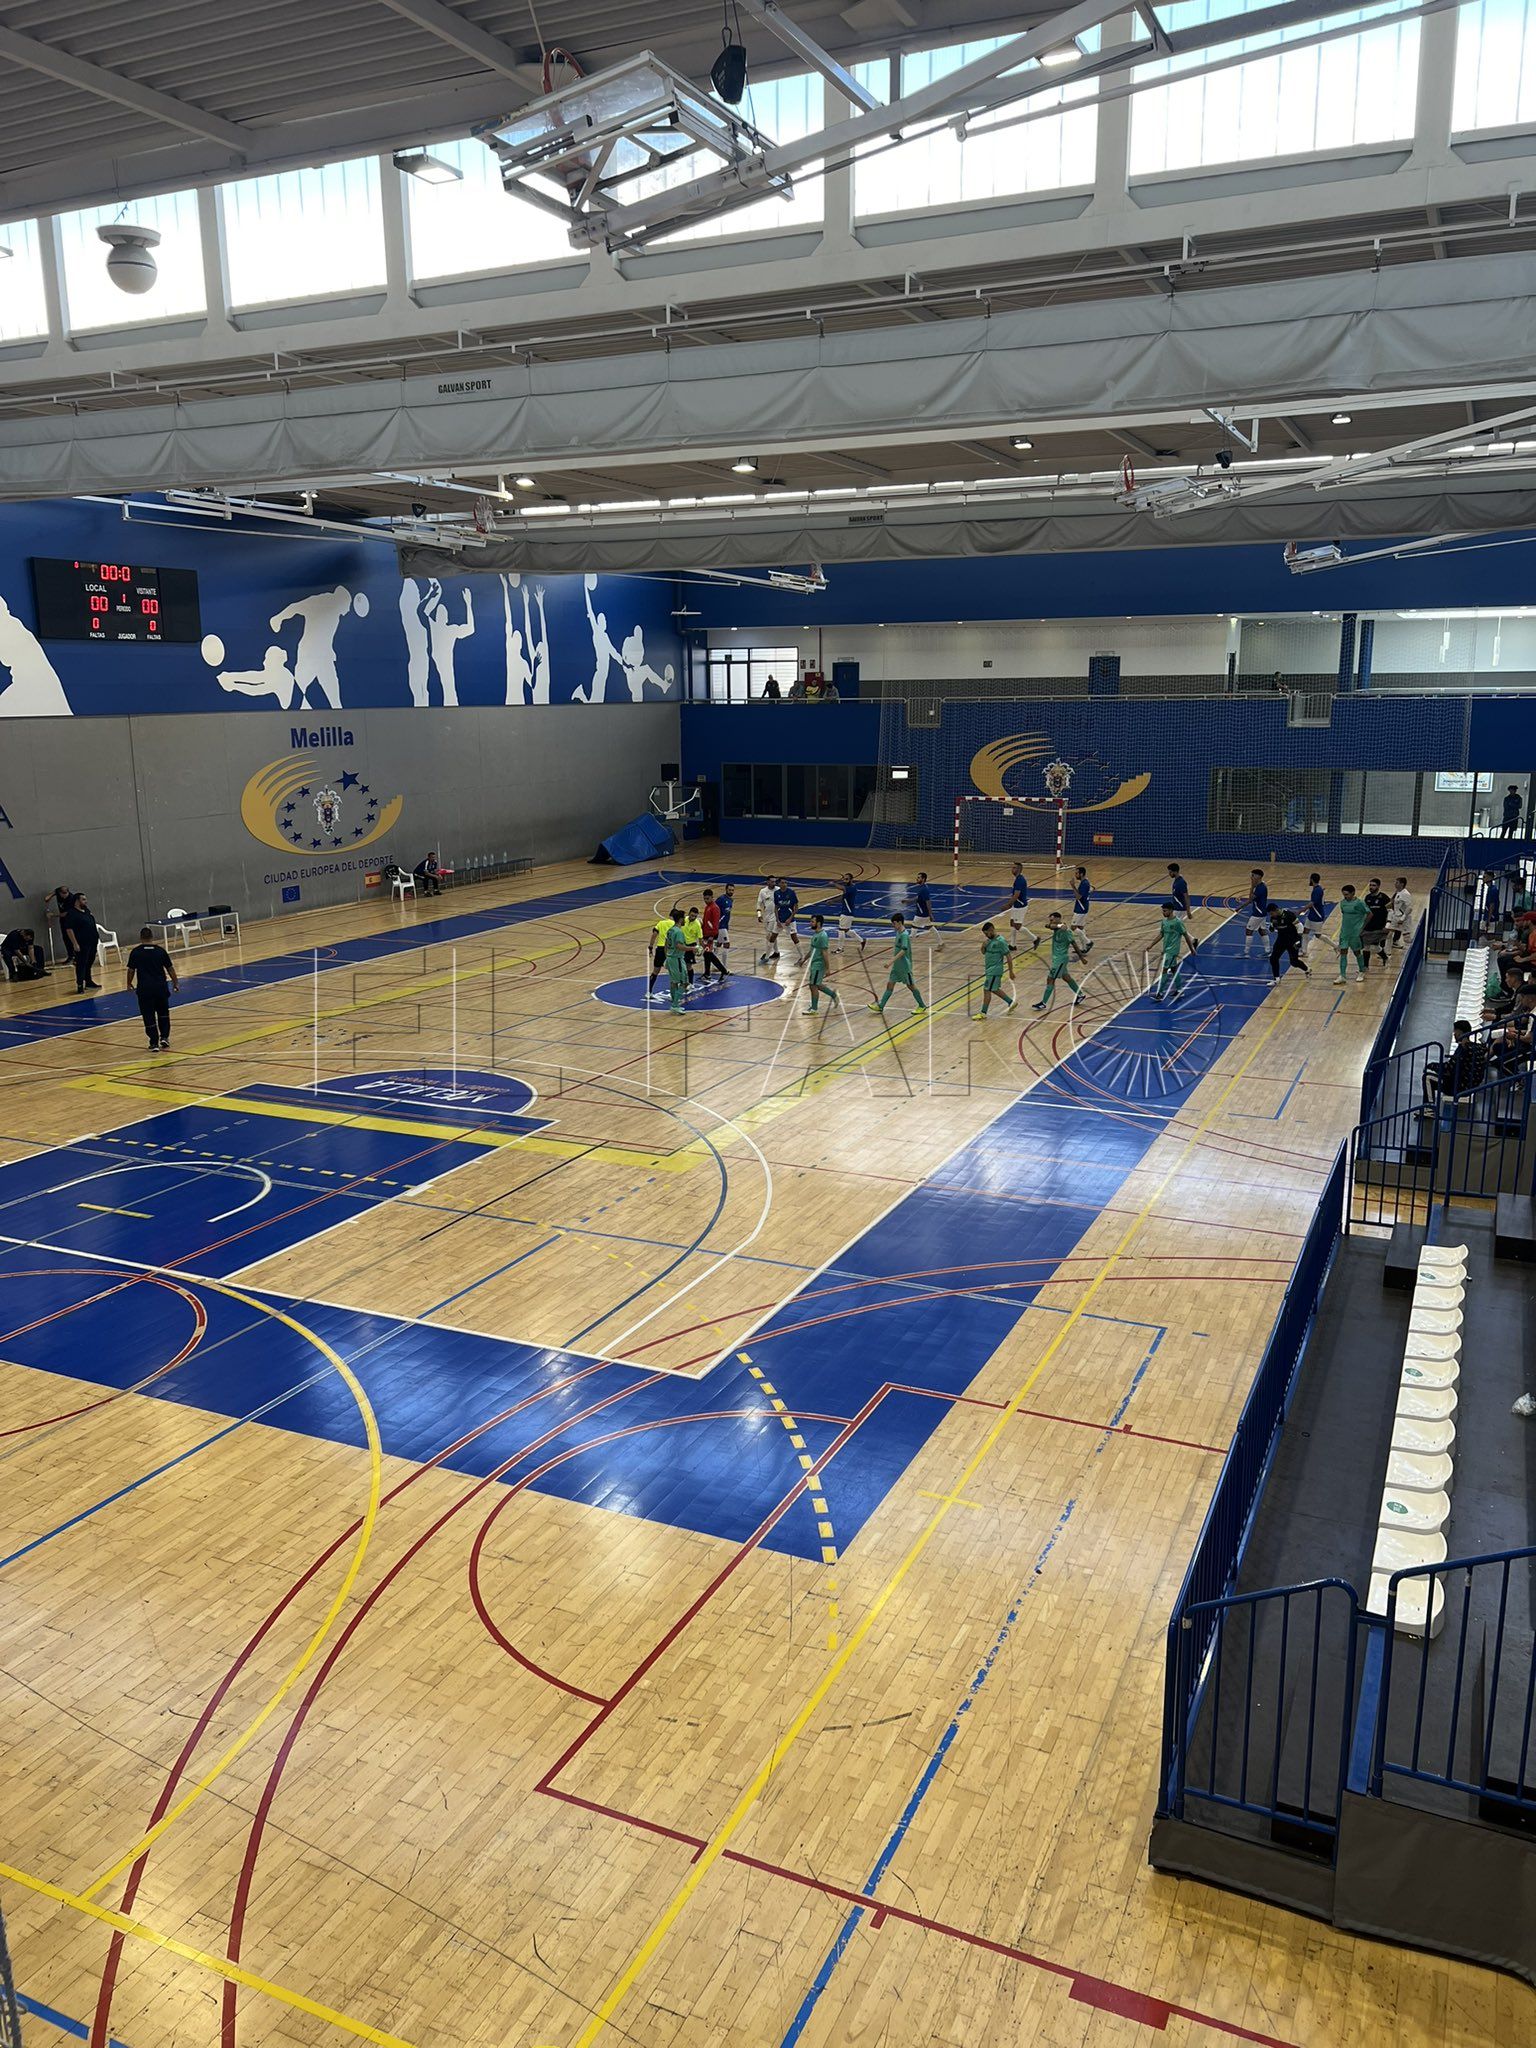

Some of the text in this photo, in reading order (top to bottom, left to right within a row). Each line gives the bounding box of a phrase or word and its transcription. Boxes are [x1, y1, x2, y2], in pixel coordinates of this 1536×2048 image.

[438, 380, 492, 394] GALVAN SPORT
[85, 584, 107, 592] LOCAL
[90, 596, 108, 612] 00
[142, 598, 158, 614] 00
[290, 726, 354, 748] Melilla
[264, 854, 394, 884] CIUDAD EUROPEA DEL DEPORTE
[354, 1080, 498, 1102] MELILLA
